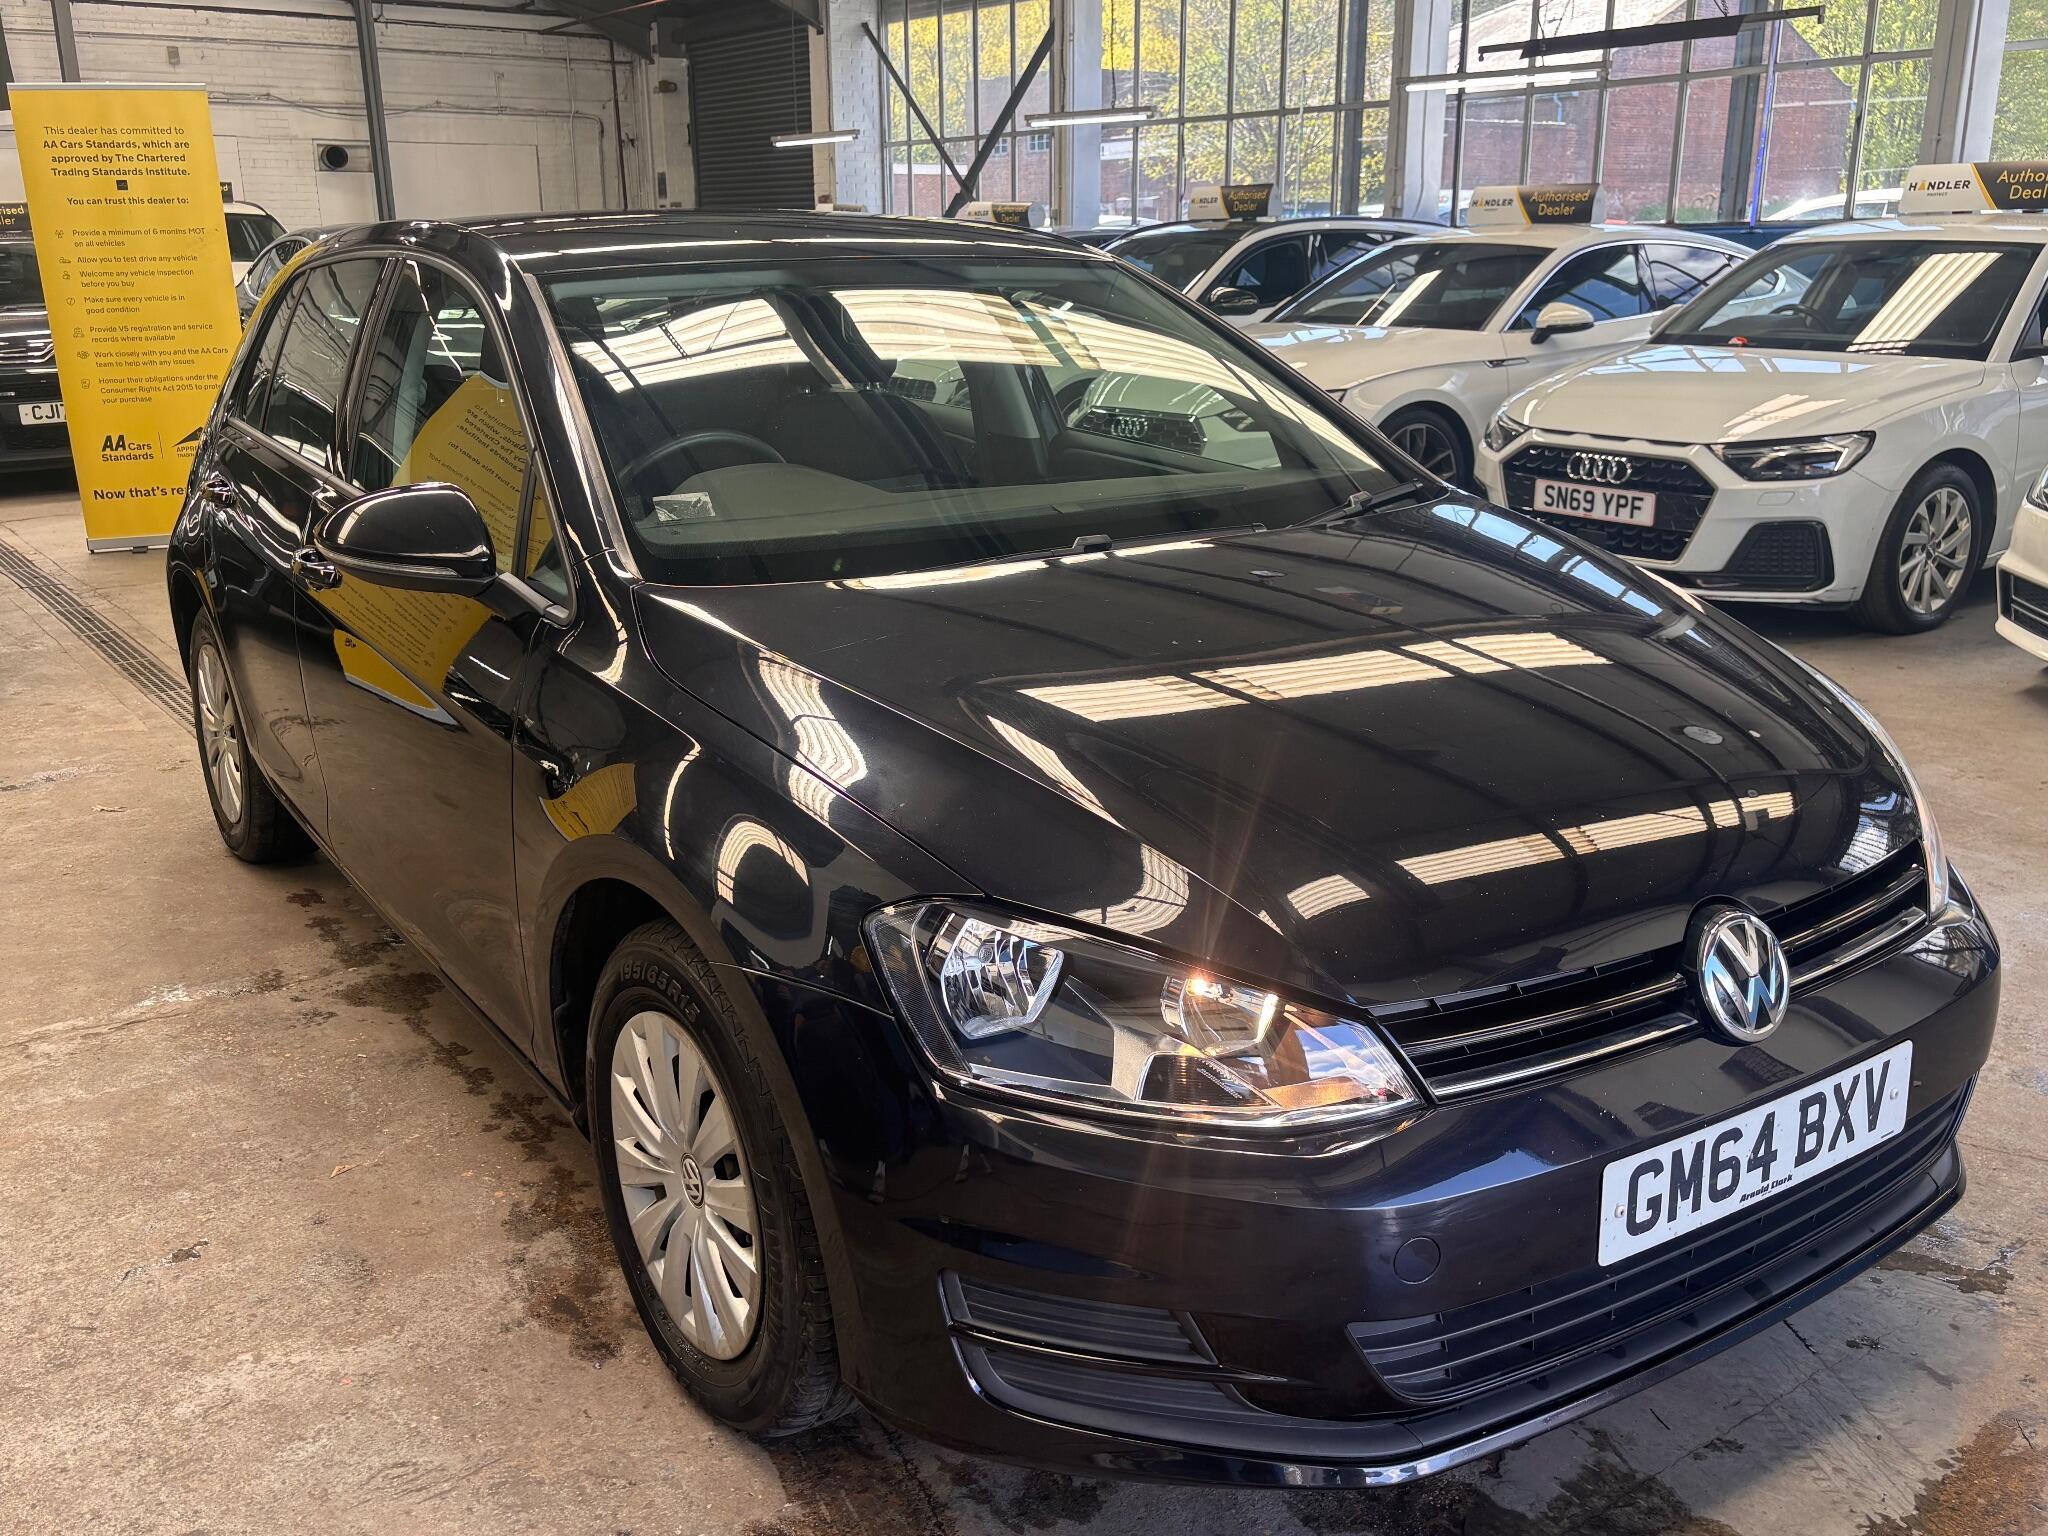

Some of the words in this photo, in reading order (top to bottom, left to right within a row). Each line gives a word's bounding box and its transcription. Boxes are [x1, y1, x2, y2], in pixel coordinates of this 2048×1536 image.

[43, 125, 65, 135] This
[67, 125, 98, 135] dealer
[100, 125, 118, 135] has
[120, 124, 172, 135] committed
[174, 125, 185, 135] to
[43, 140, 58, 149] AA
[59, 140, 84, 149] Cars
[85, 139, 140, 150] Standards,
[142, 139, 172, 149] which
[174, 140, 190, 149] are
[51, 153, 99, 164] approved
[101, 153, 113, 164] by
[114, 153, 134, 163] The
[136, 153, 186, 163] Chartered
[50, 167, 90, 178] Trading
[91, 167, 144, 177] Standards
[145, 167, 191, 177] Institute.
[67, 197, 85, 205] You
[86, 197, 103, 205] can
[104, 196, 127, 205] trust
[128, 196, 146, 205] this
[147, 196, 175, 205] dealer
[176, 196, 190, 205] to:
[1530, 189, 1592, 202] Authorised
[1232, 200, 1258, 212] Dealer
[1537, 203, 1576, 216] Dealer
[72, 229, 101, 237] Provide
[108, 228, 142, 236] minimum
[188, 227, 206, 235] MOT
[85, 239, 95, 247] all
[95, 239, 126, 247] vehicles
[99, 256, 113, 264] you
[123, 255, 137, 263] test
[138, 254, 157, 262] drive
[158, 255, 171, 263] any
[172, 253, 198, 262] vehicle
[79, 270, 114, 278] Welcome
[115, 270, 129, 278] any
[130, 269, 156, 277] vehicle
[157, 268, 194, 277] inspection
[81, 280, 105, 288] before
[107, 280, 120, 289] you
[121, 279, 135, 288] buy
[84, 296, 104, 304] Make
[122, 296, 143, 304] every
[143, 294, 170, 302] vehicle
[85, 307, 105, 315] good
[90, 325, 117, 333] Provide
[130, 323, 172, 333] registration
[172, 323, 187, 331] and
[187, 322, 213, 331] service
[91, 335, 119, 343] records
[144, 333, 176, 342] available
[93, 350, 114, 358] Work
[115, 349, 140, 359] closely
[141, 349, 158, 357] with
[158, 349, 172, 358] you
[172, 348, 187, 356] and
[187, 347, 200, 355] the
[200, 347, 212, 355] AA
[212, 347, 229, 355] Cars
[95, 360, 114, 368] team
[124, 359, 141, 367] help
[141, 359, 158, 367] with
[158, 359, 171, 367] any
[98, 377, 126, 385] Honour
[126, 376, 144, 384] their
[144, 375, 184, 384] obligations
[184, 374, 206, 382] under
[206, 373, 219, 381] the
[100, 386, 138, 394] Consumer
[138, 385, 162, 394] Rights
[162, 384, 176, 392] Act
[176, 383, 194, 391] 2015
[102, 397, 118, 405] your
[101, 434, 127, 452] AA
[128, 442, 153, 452] Cars
[101, 452, 154, 462] Standards
[93, 489, 126, 501] Now
[129, 486, 168, 499] that's
[170, 486, 188, 497] re
[1543, 484, 1596, 514] SN69
[1602, 491, 1645, 520] YPF
[1625, 1109, 1779, 1238] GM64
[1793, 1059, 1891, 1170] BXV
[1770, 1173, 1793, 1190] Clark
